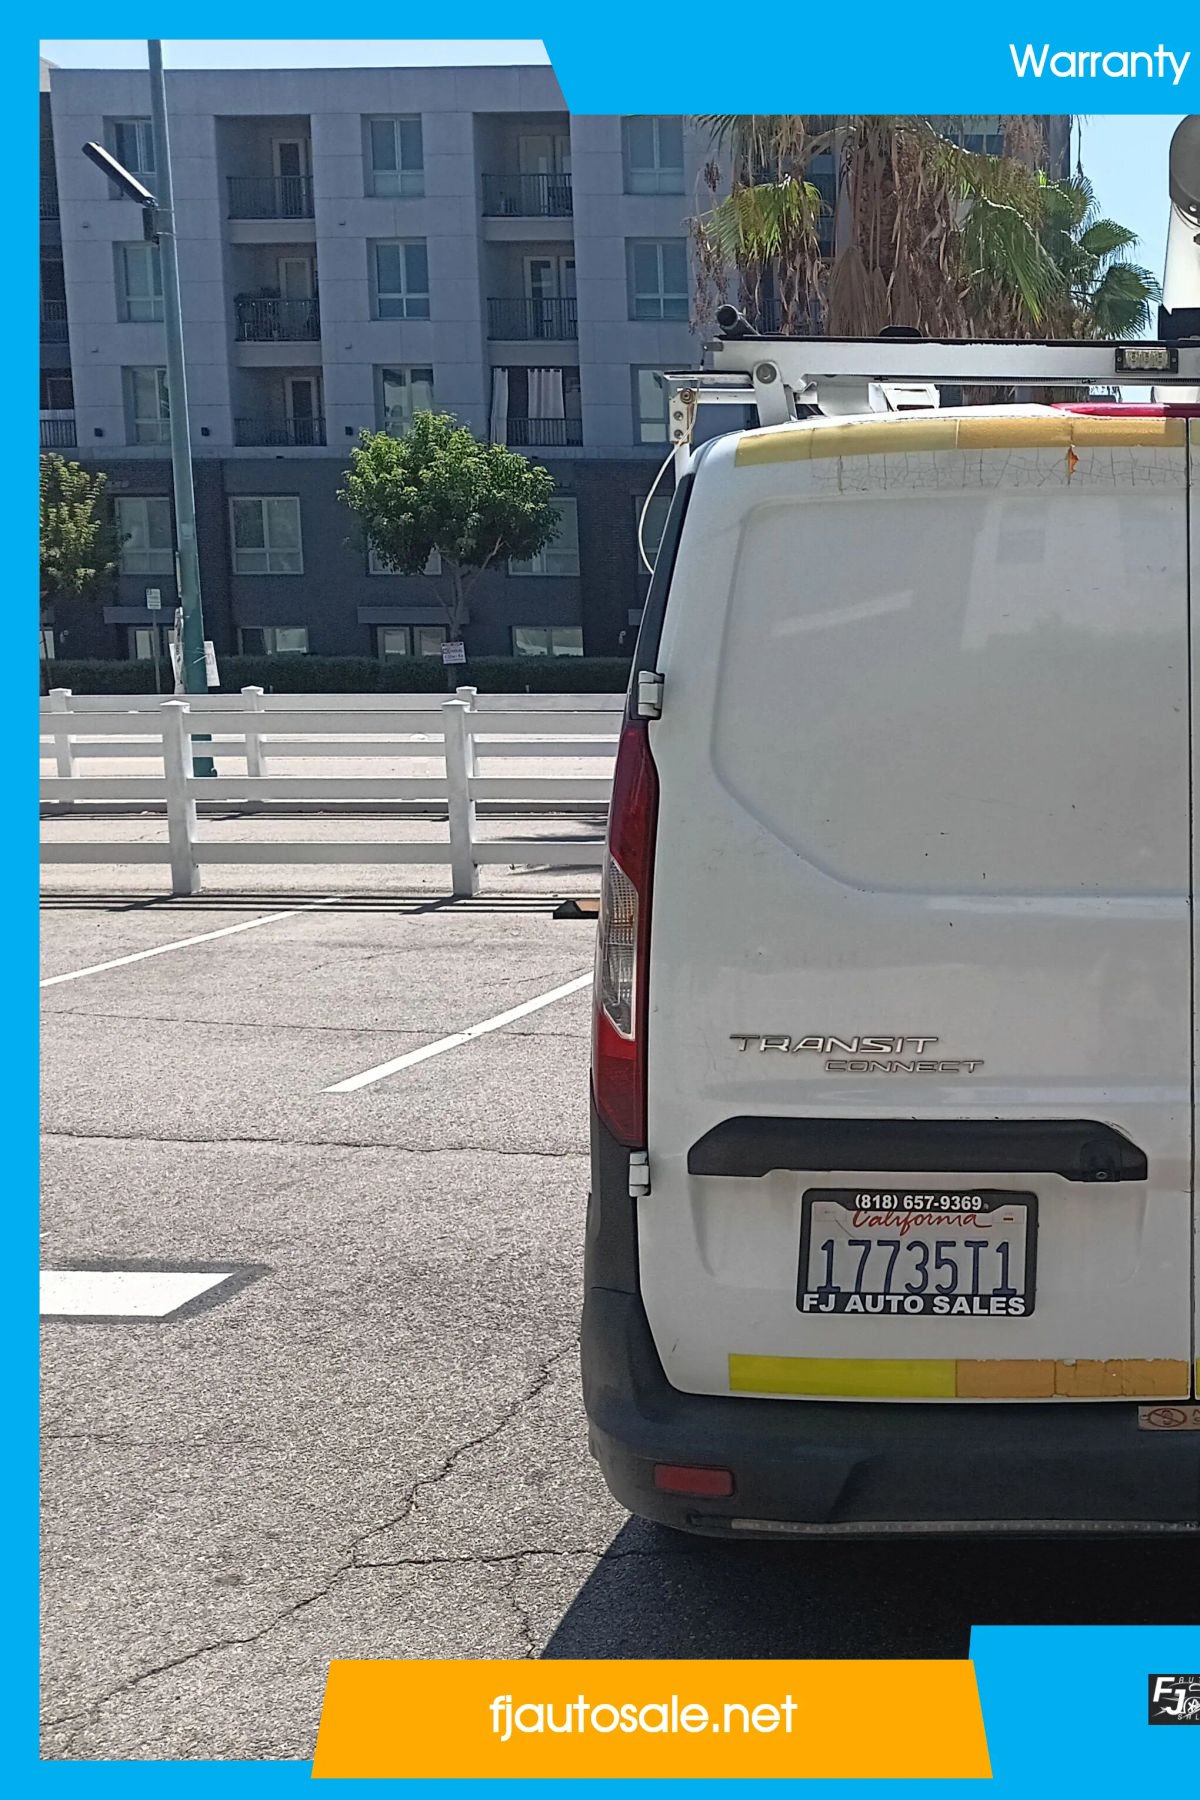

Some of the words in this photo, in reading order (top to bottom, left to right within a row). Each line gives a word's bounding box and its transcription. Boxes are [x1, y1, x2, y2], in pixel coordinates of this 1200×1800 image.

[729, 1034, 939, 1054] TRANSIT
[825, 1060, 985, 1074] CONNECT
[855, 1194, 898, 1210] (818)
[903, 1195, 982, 1211] 657-9369
[852, 1210, 993, 1236] California
[816, 1239, 1017, 1295] 17735T1
[803, 1293, 836, 1312] FJ
[845, 1294, 924, 1314] AUTO
[932, 1296, 1026, 1315] SALES
